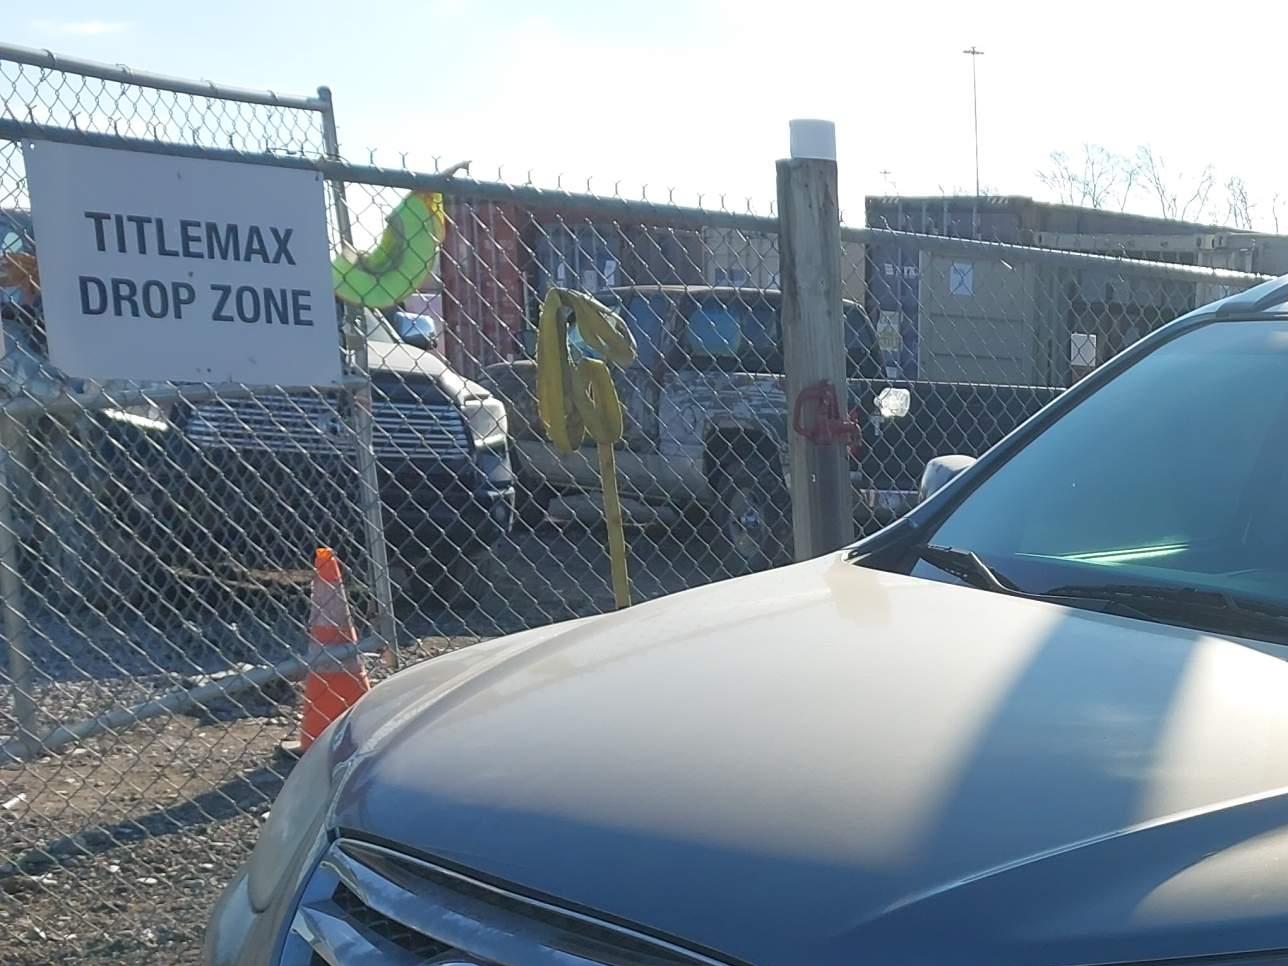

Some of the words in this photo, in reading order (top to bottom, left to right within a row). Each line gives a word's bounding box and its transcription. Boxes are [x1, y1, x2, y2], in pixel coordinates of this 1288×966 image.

[85, 211, 297, 265] TITLEMAX
[78, 275, 196, 320] DROP
[210, 283, 315, 327] ZONE
